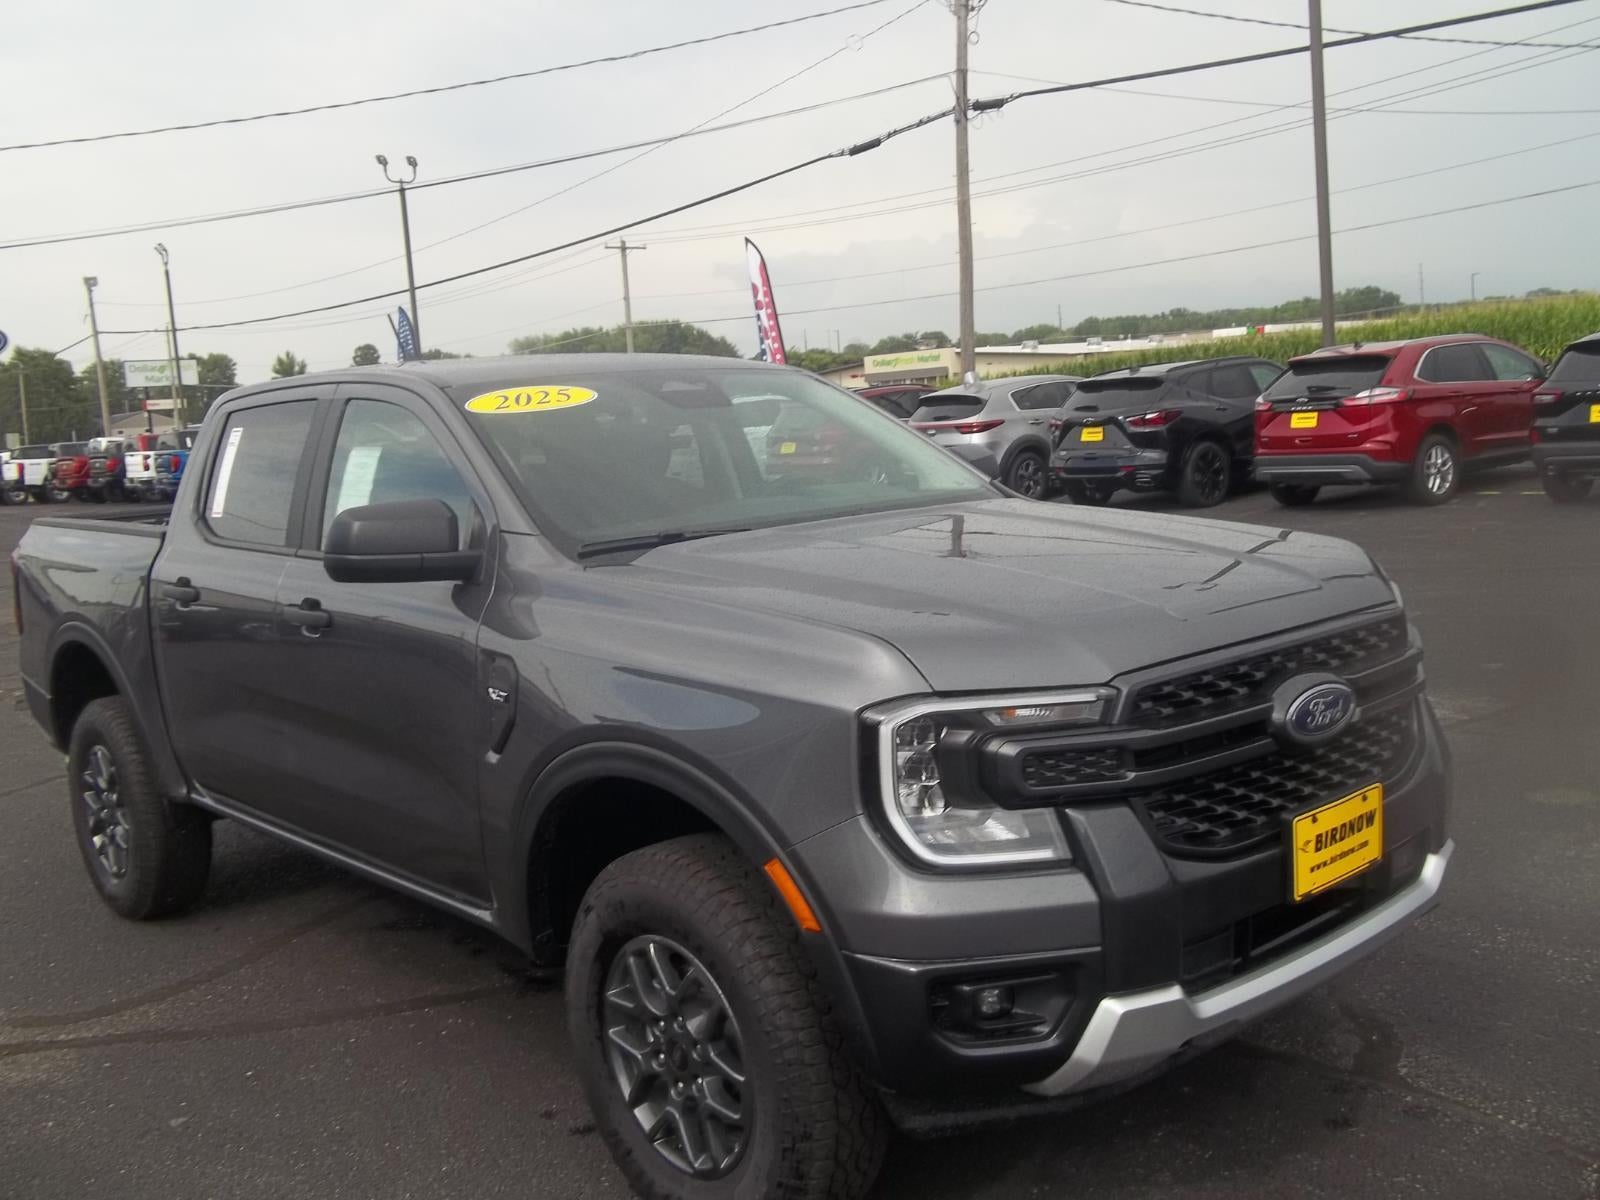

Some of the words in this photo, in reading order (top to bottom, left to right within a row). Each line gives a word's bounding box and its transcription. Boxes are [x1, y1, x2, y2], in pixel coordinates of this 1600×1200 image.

[494, 388, 571, 411] 2025
[1306, 695, 1344, 727] Ford
[1314, 807, 1377, 853] BIRDNOW
